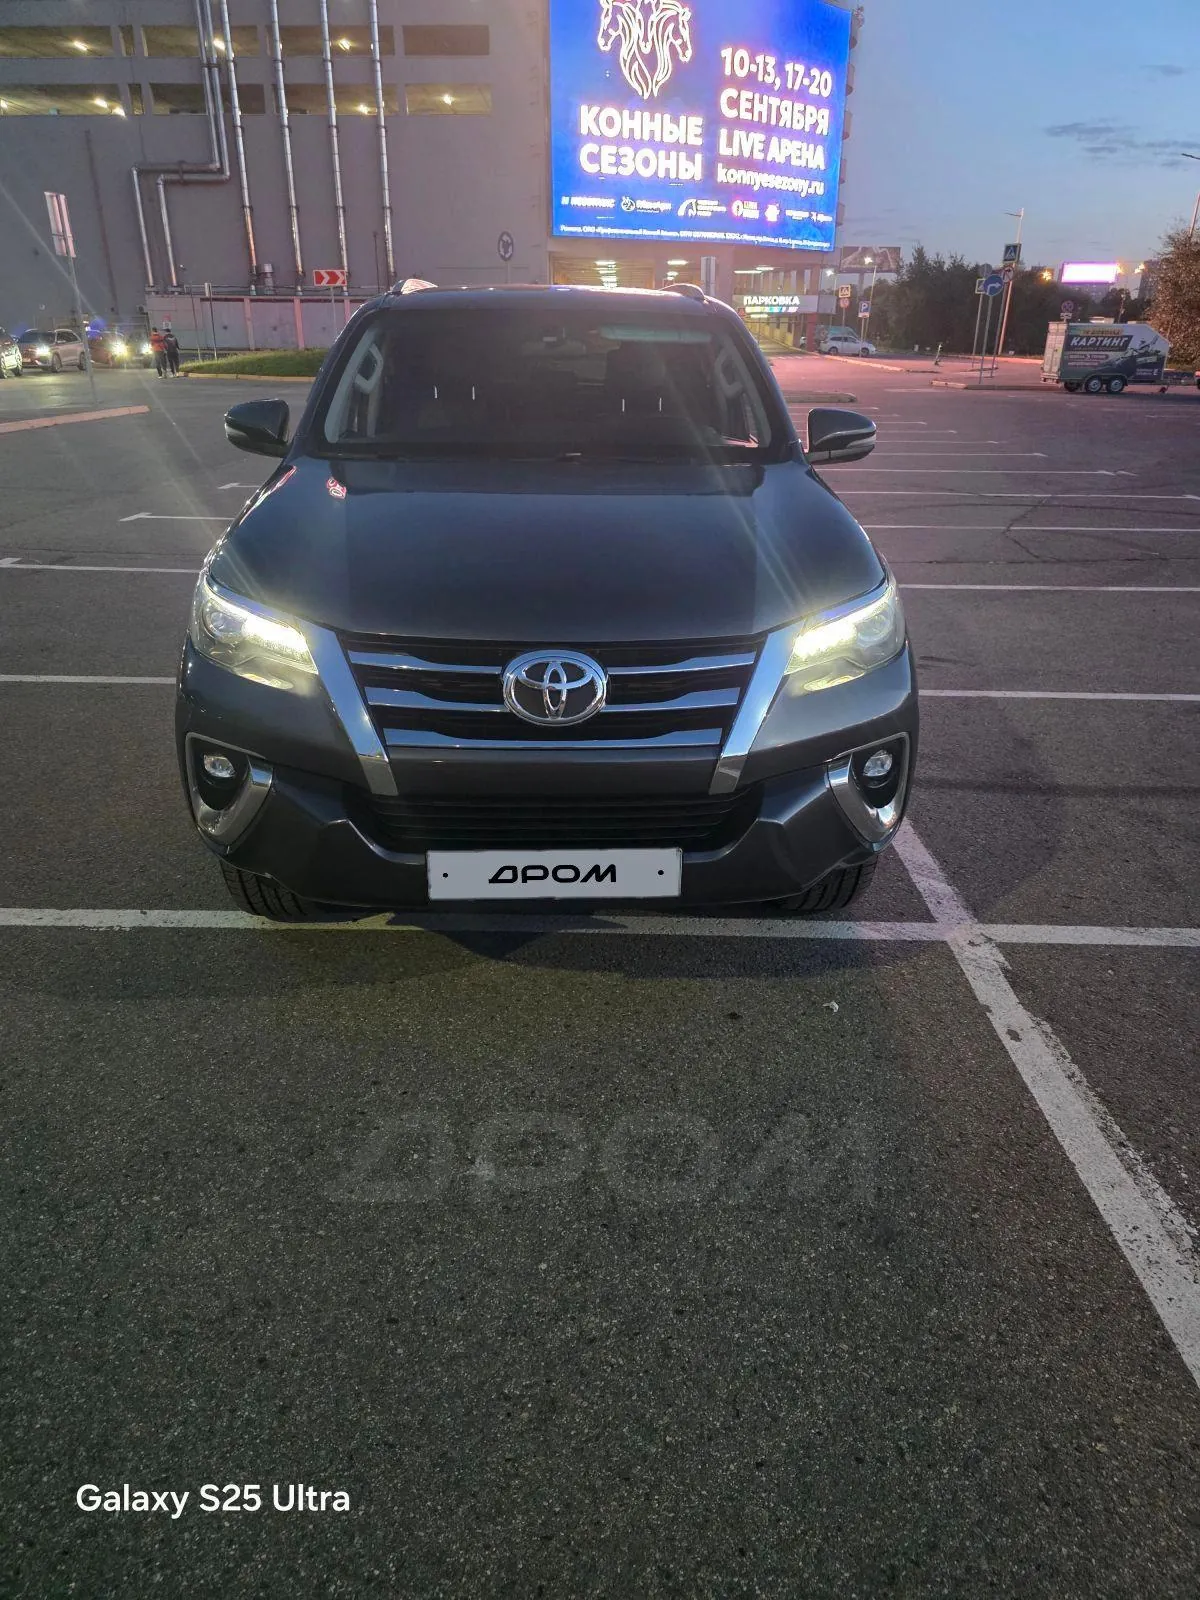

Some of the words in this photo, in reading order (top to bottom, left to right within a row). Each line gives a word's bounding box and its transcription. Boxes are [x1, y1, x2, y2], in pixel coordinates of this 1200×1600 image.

[721, 48, 780, 91] 10-13,
[785, 62, 832, 97] 17-20
[580, 105, 703, 145] КОННЫЕ
[720, 88, 830, 135] СЕНТЯБРЯ
[580, 143, 702, 180] СЕЗОНЫ
[719, 128, 766, 160] LIVE
[767, 136, 826, 170] АРЕНА
[743, 295, 800, 307] ПАРКОВКА
[1070, 336, 1129, 347] КАРТИНГ
